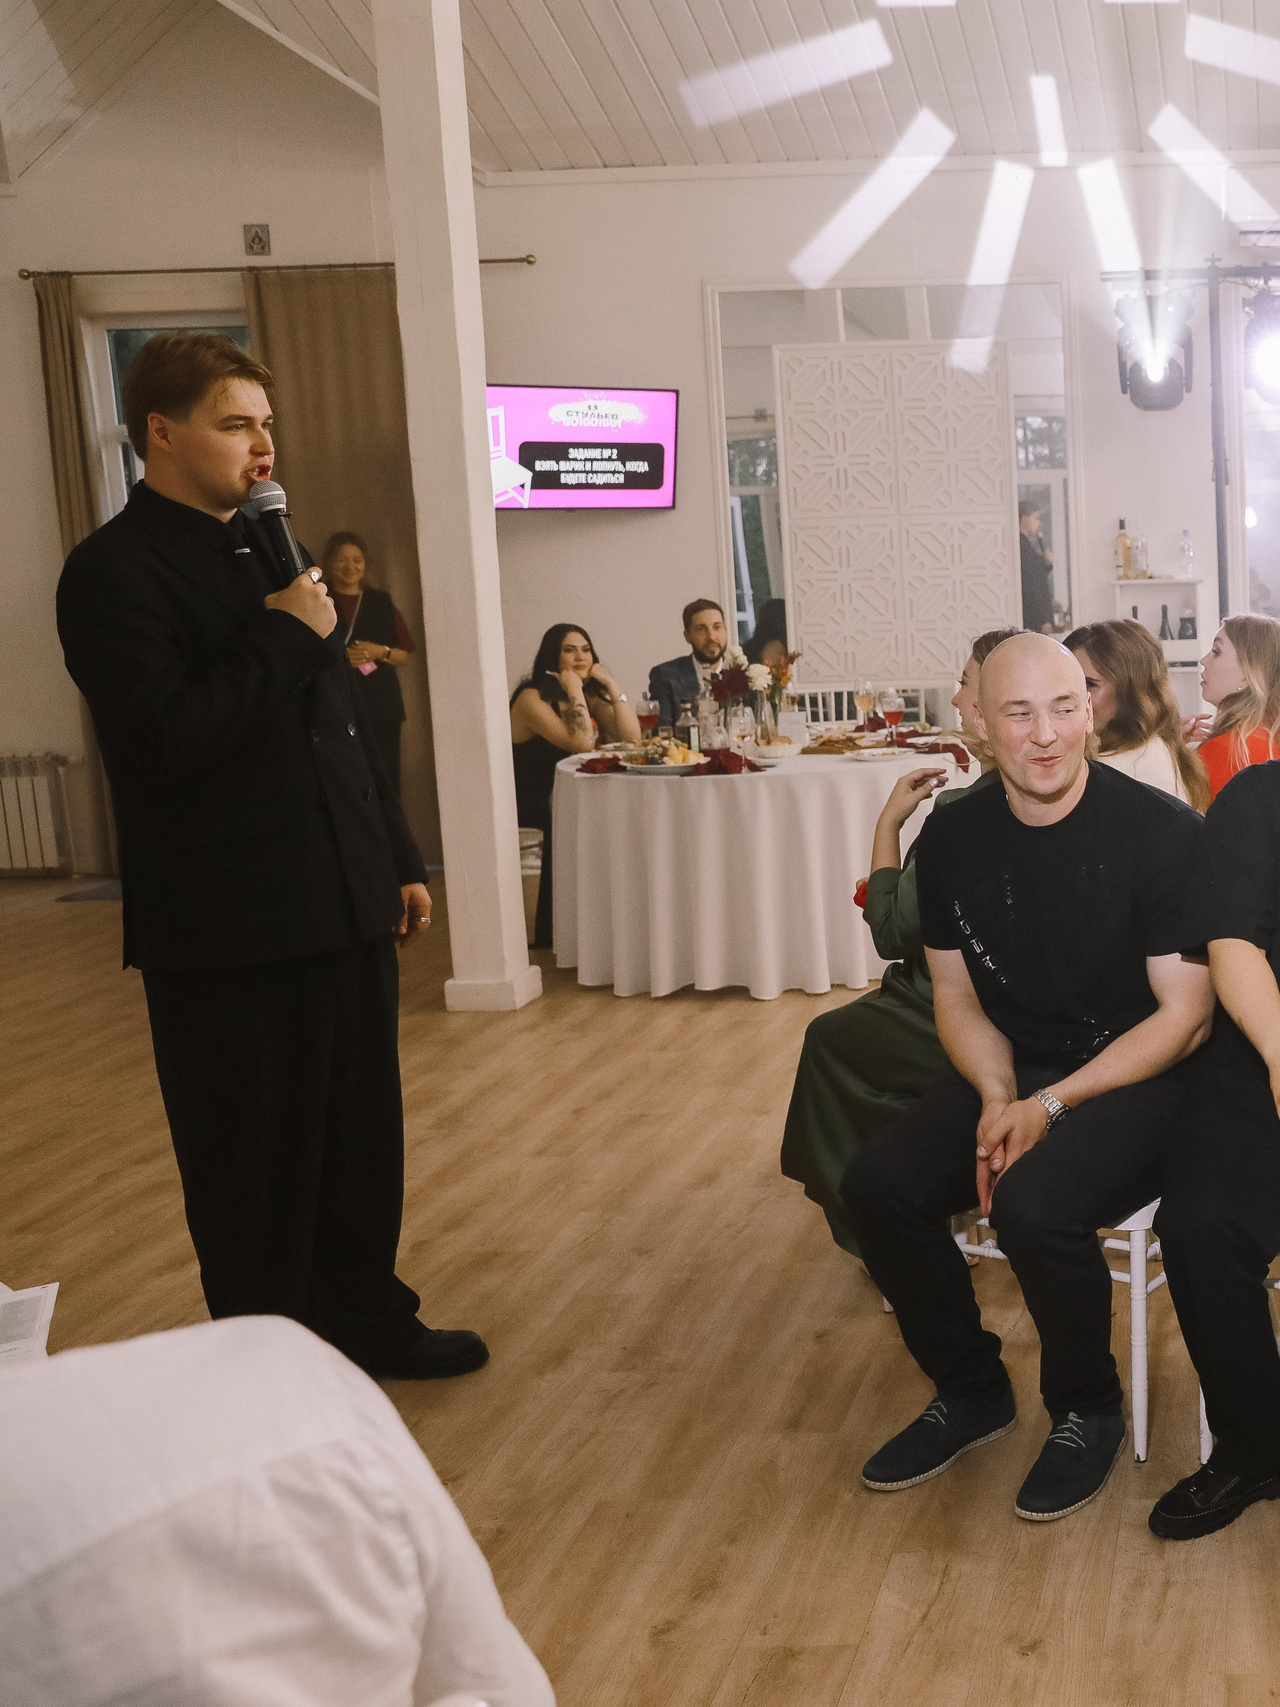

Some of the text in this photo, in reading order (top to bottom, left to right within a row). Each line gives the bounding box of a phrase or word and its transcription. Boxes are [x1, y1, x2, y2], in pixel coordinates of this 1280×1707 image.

[566, 410, 619, 420] СТУЛЬЕВ
[568, 448, 602, 460] ЗАДАНИЕ
[611, 448, 618, 459] 2
[535, 460, 649, 473] ВЗЯТЬ ШАРИК И ЛОПНУТЬ, КОГДА
[560, 472, 625, 485] БУДЕТЕ САДИТЬСЯ
